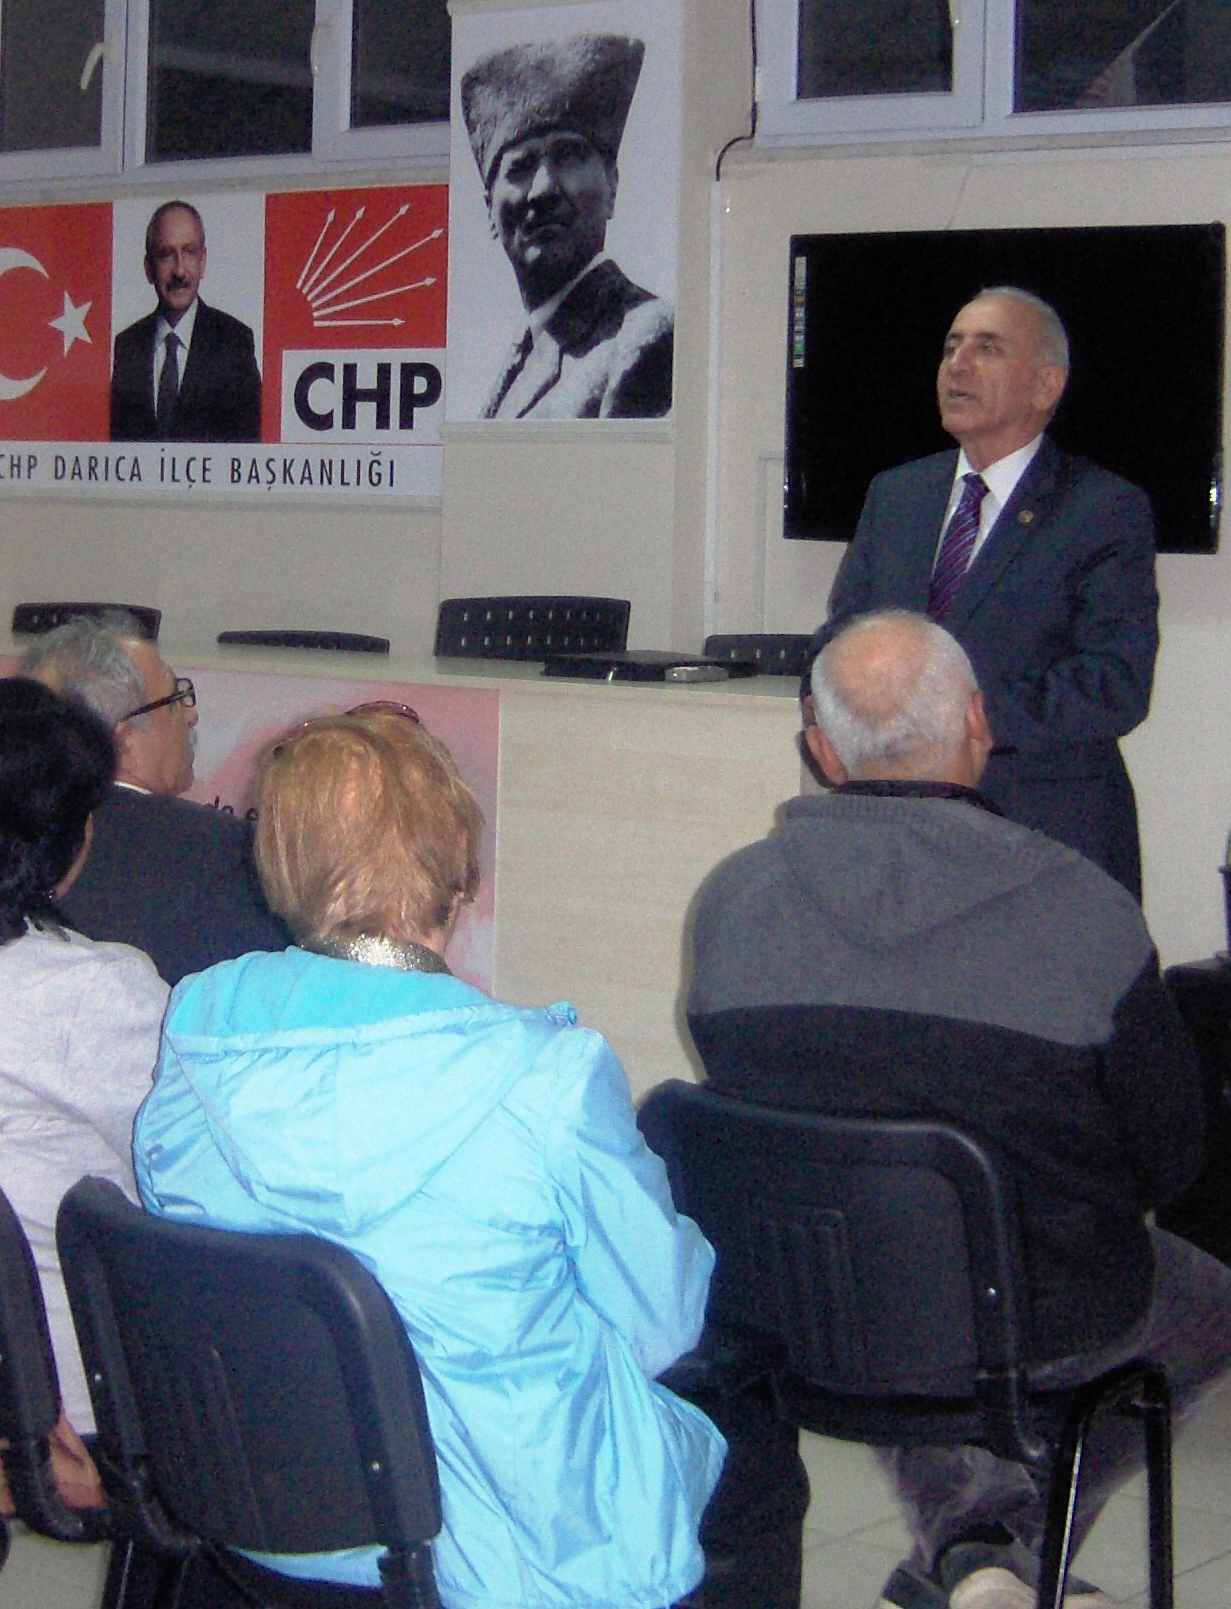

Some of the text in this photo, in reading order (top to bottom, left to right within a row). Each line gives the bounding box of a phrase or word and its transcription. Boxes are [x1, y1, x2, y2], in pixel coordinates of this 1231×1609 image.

[293, 361, 443, 432] CHP
[54, 455, 142, 482] DARICA
[159, 447, 212, 489] İLÇE
[230, 450, 395, 491] BAŞKANLIĞI
